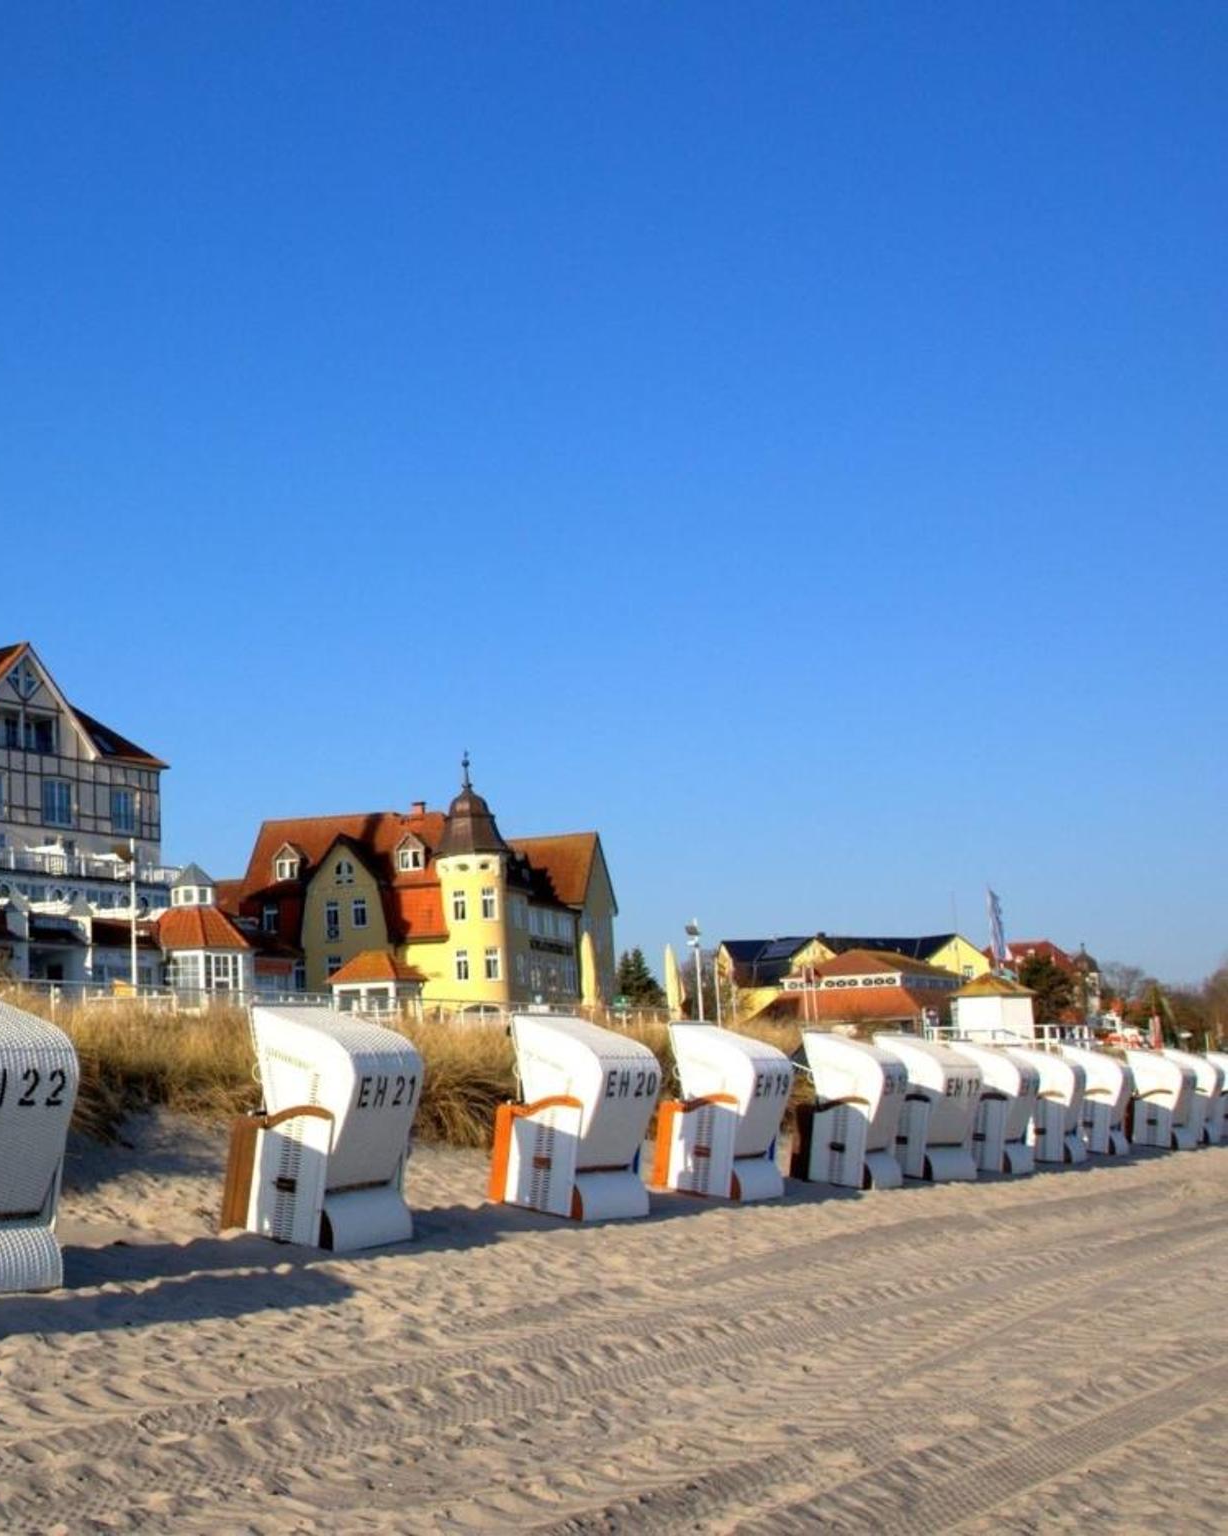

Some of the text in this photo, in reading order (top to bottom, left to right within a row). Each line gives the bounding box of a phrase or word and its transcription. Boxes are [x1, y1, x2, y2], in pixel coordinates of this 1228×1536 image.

[18, 1068, 66, 1106] 22
[357, 1075, 416, 1109] EH 21
[605, 1070, 657, 1098] EH 20
[755, 1073, 789, 1097] EH 19
[946, 1077, 963, 1098] EH
